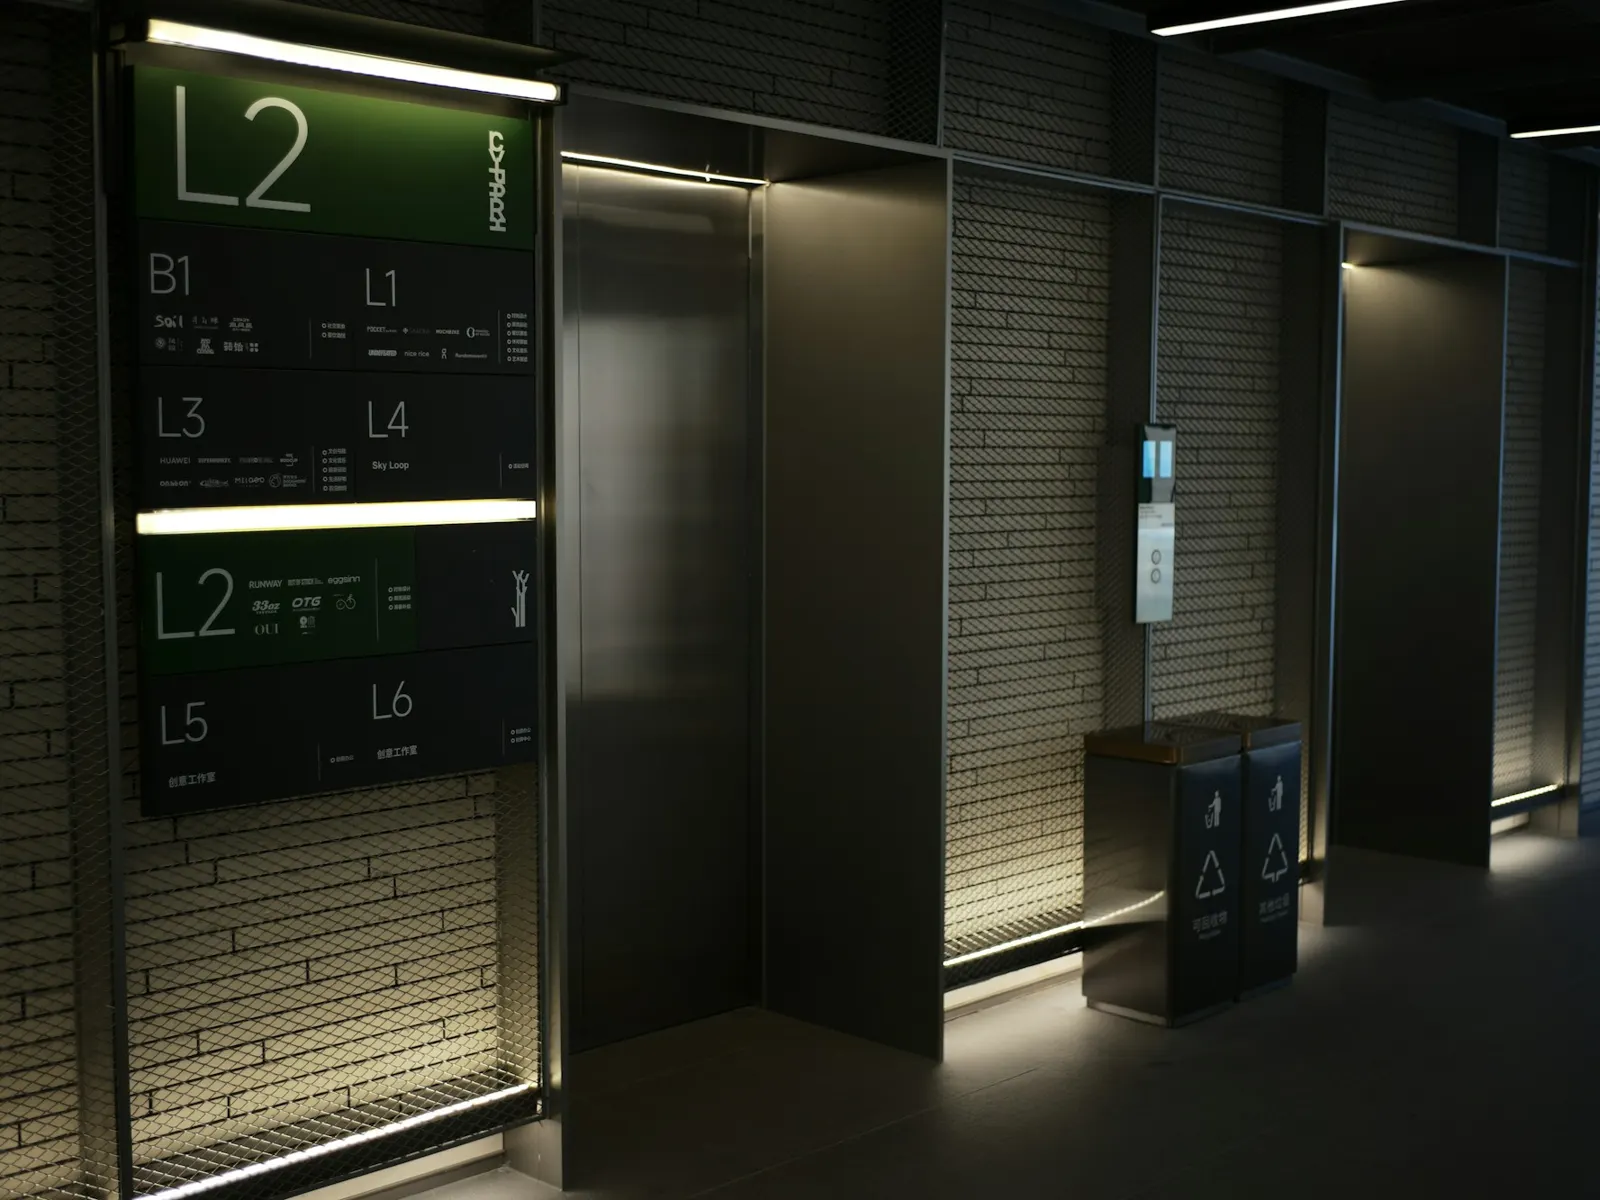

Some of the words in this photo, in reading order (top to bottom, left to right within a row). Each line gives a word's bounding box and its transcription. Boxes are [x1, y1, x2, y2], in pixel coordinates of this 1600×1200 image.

[176, 85, 311, 212] L2
[150, 252, 190, 296] B1
[365, 267, 396, 307] L1
[404, 350, 419, 358] nice
[420, 350, 431, 358] rice
[157, 396, 206, 438] L3
[368, 401, 409, 438] L4
[159, 456, 191, 465] HUAWEI
[372, 460, 388, 472] Sky
[389, 460, 410, 471] Loop
[248, 579, 283, 589] RUNWAY
[327, 575, 361, 585] eggsinn
[156, 567, 236, 640] L2
[291, 596, 322, 608] OTG
[372, 680, 413, 720] L6
[161, 701, 208, 745] L5
[376, 744, 418, 760] 创意工作室
[168, 771, 216, 789] 创意工作室
